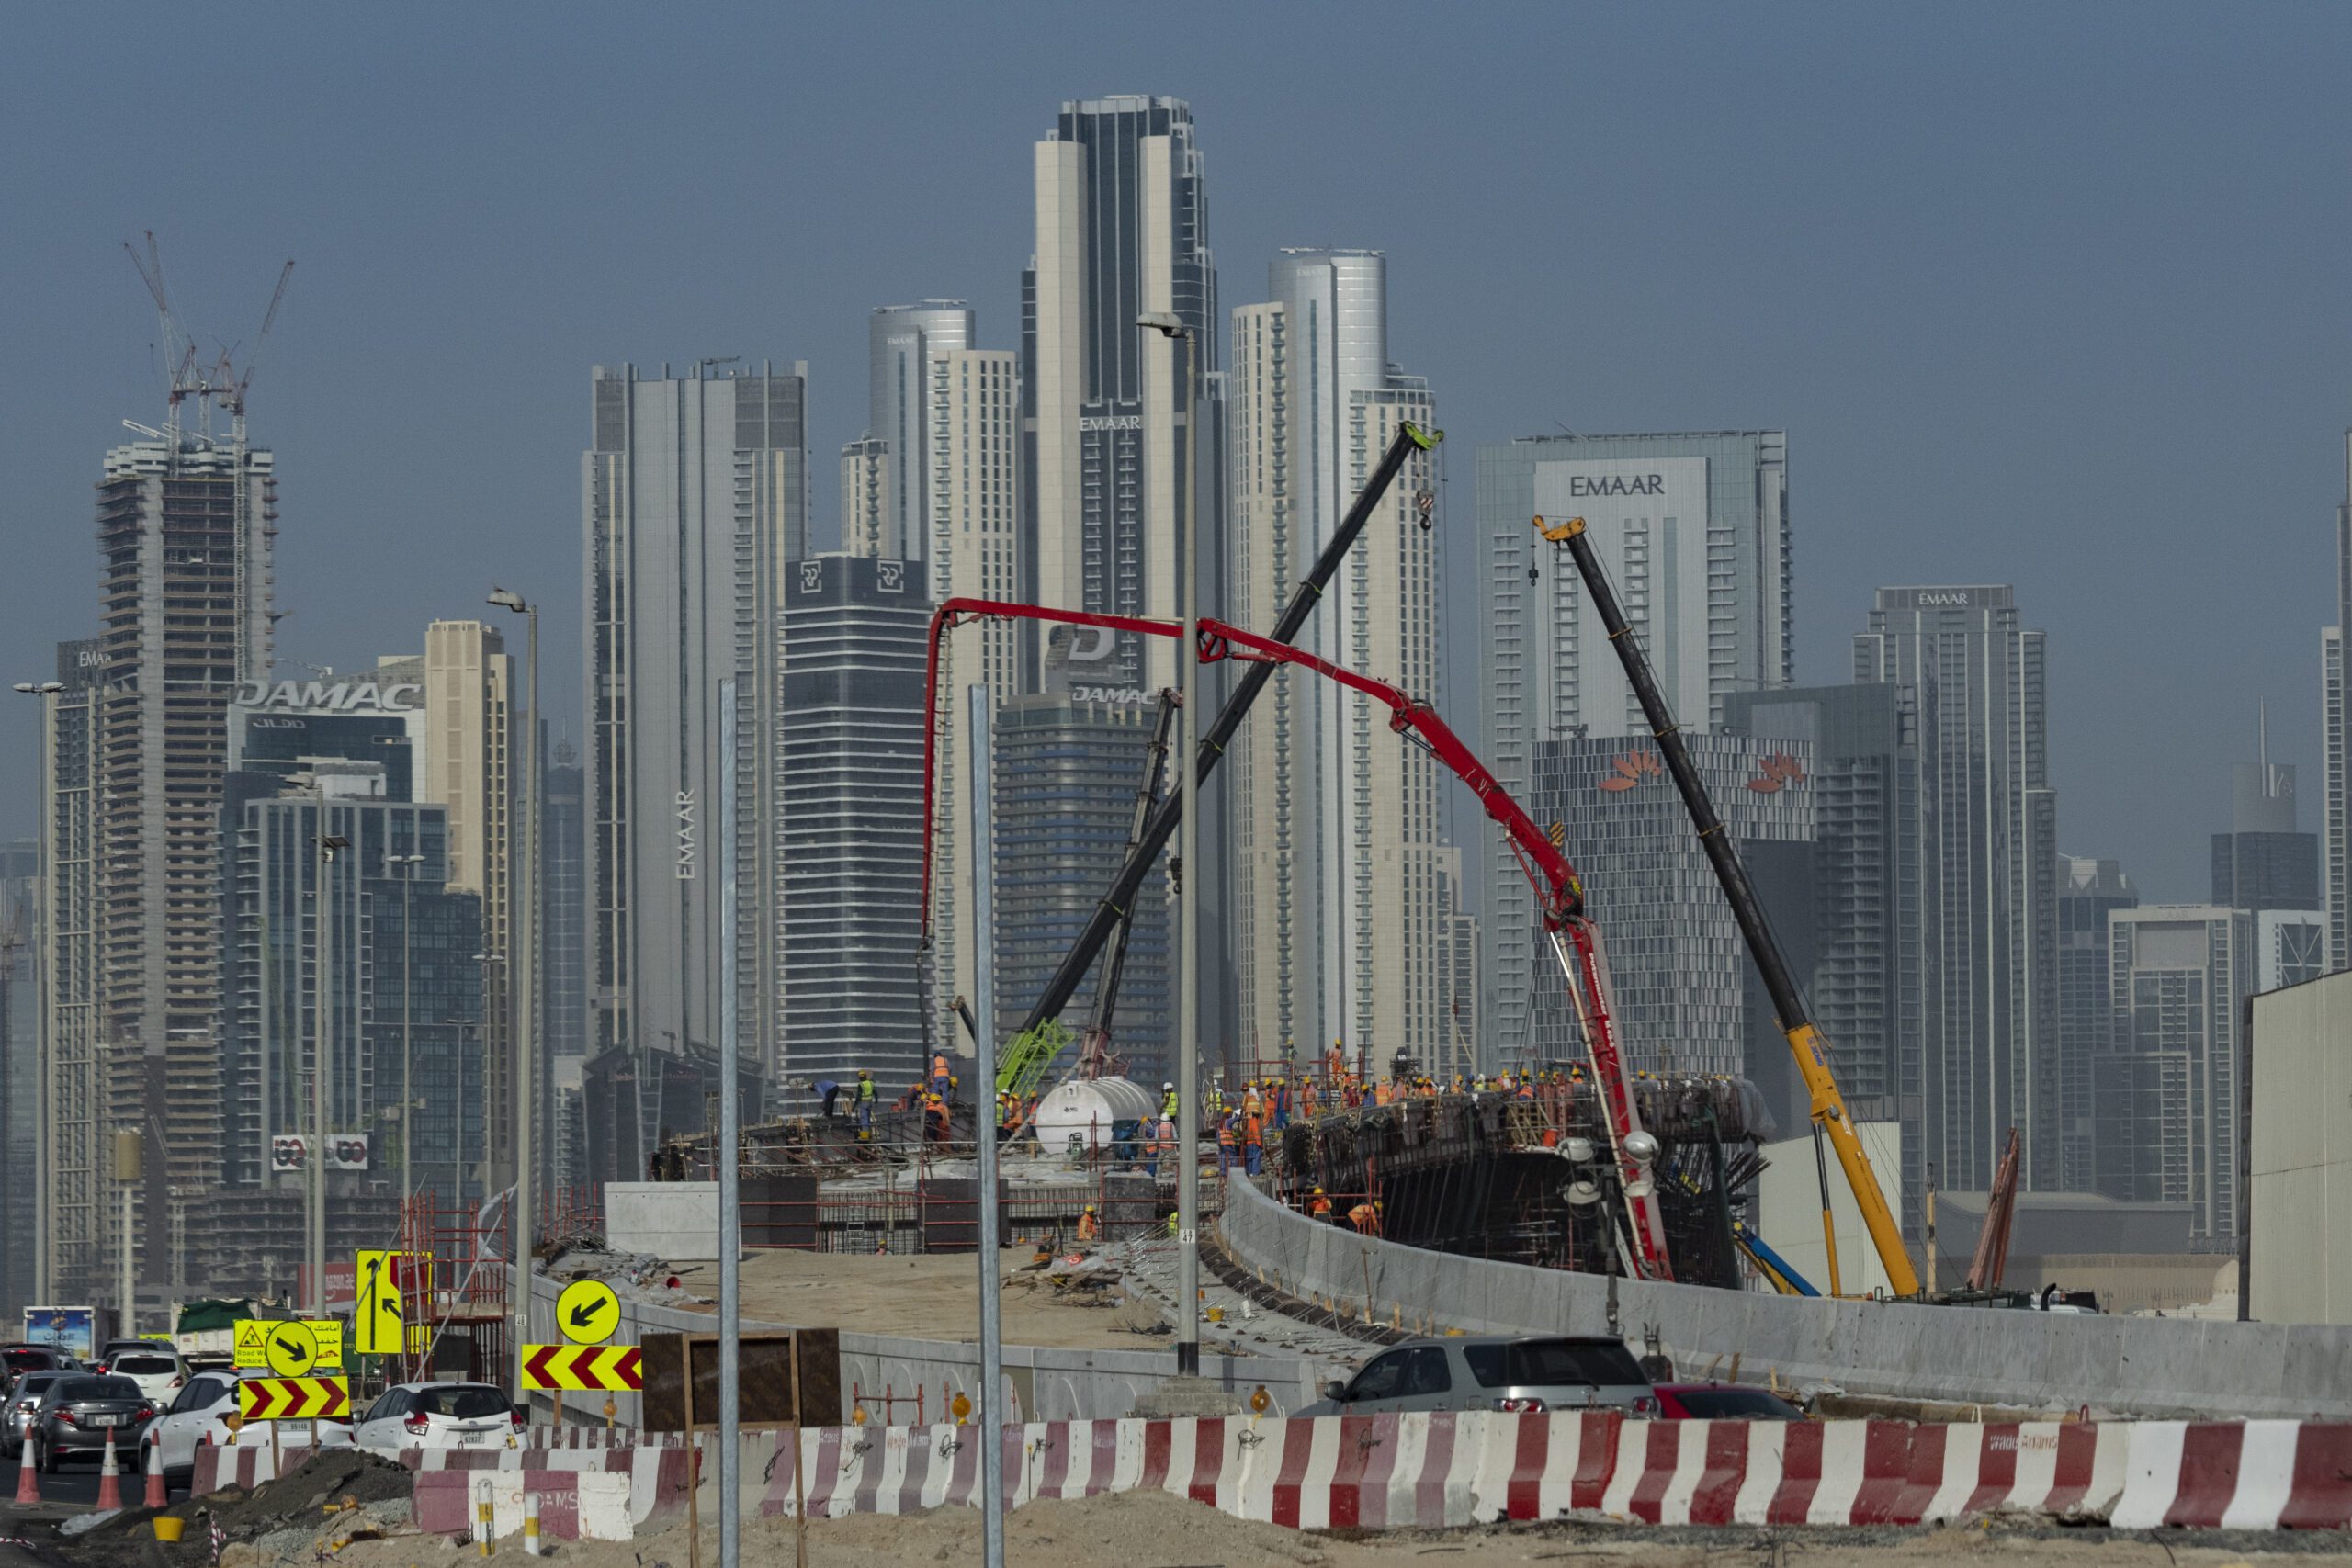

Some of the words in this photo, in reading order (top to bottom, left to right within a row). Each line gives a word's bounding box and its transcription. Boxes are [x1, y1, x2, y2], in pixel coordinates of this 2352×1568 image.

[1080, 416, 1142, 432] EMAAR
[1570, 474, 1666, 497] EMAAR
[1918, 592, 1969, 605] EMAAR
[234, 679, 422, 711] DAMAC
[1071, 686, 1159, 705] DAMAC
[675, 788, 695, 880] EMAAR
[2021, 1434, 2058, 1450] Adams
